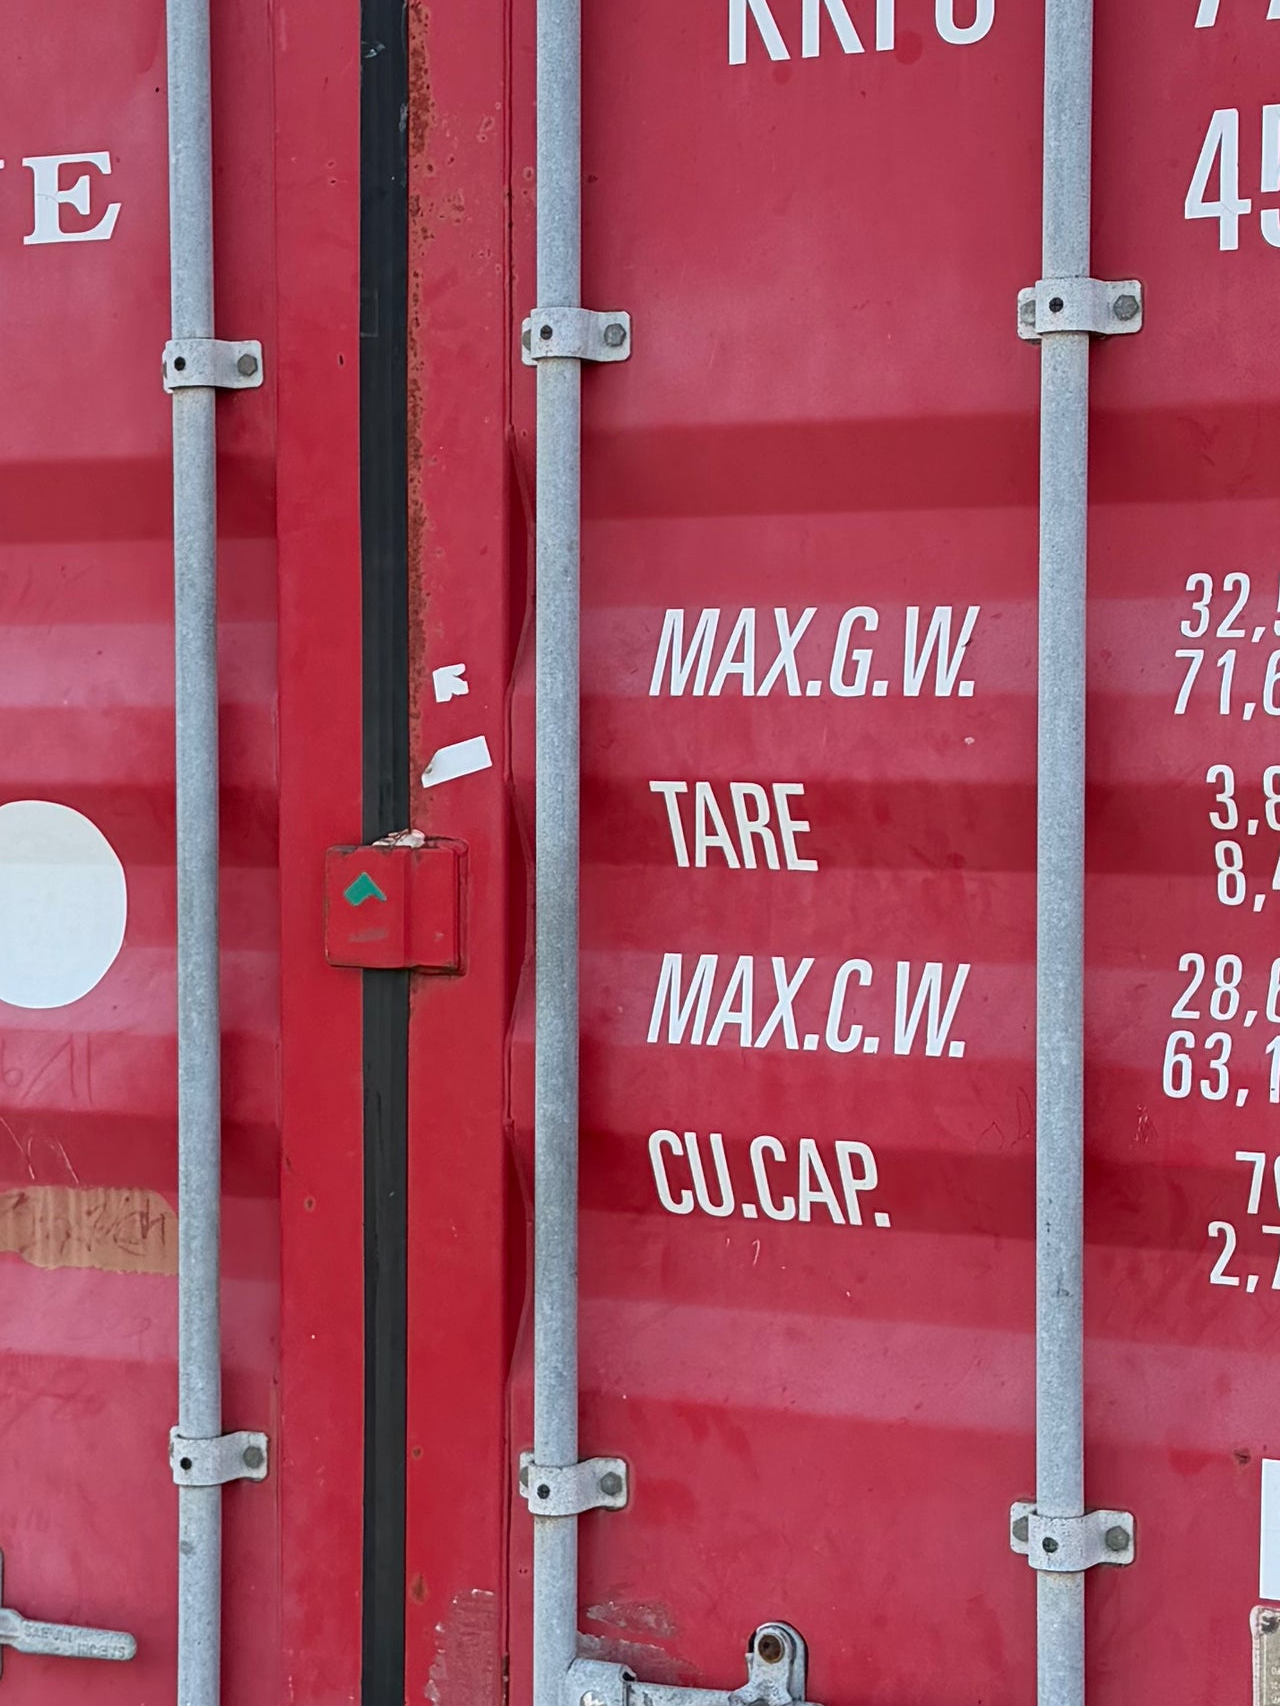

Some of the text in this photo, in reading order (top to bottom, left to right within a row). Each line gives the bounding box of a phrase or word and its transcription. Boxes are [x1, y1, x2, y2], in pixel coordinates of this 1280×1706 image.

[649, 605, 980, 698] MAX.G.W.
[650, 780, 819, 872] TARE
[647, 952, 970, 1058] MAX.C.W.
[649, 1129, 891, 1228] CU.CAP.
